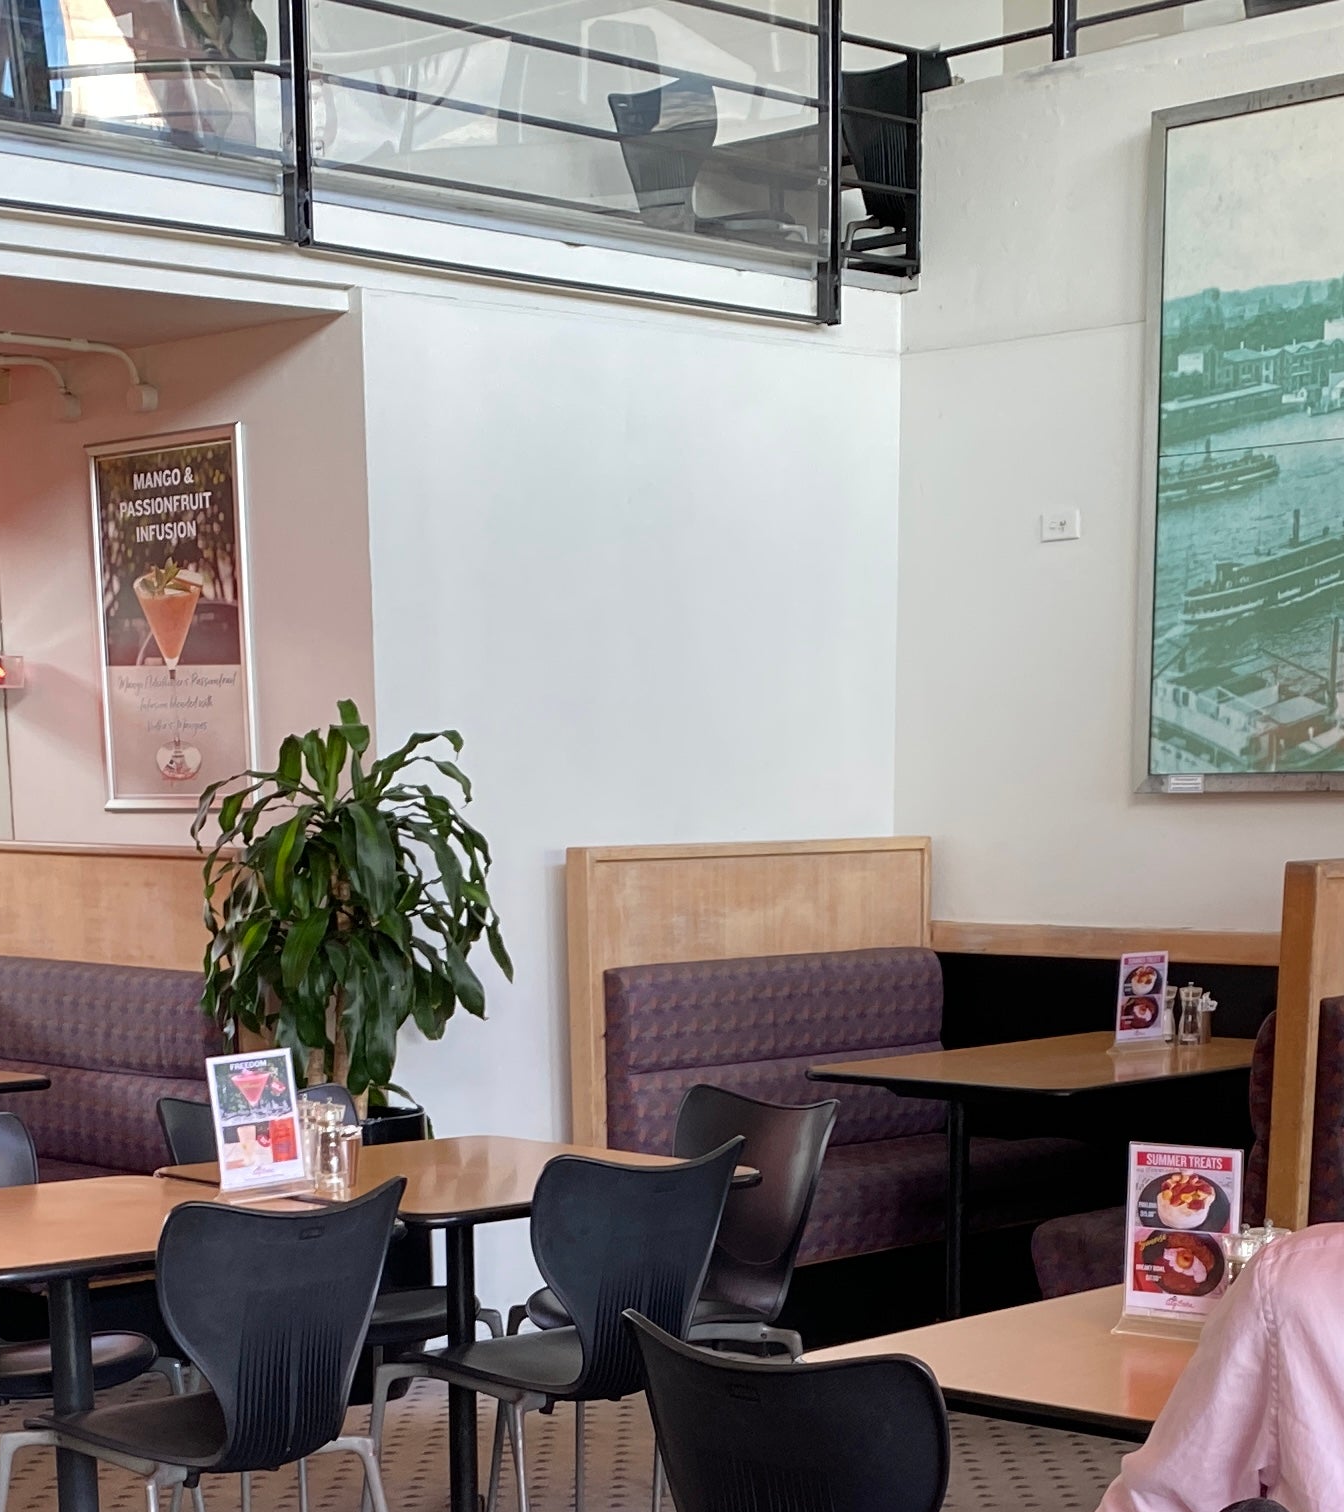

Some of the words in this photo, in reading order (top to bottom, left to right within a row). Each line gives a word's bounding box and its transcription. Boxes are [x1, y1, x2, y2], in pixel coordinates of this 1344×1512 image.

[133, 467, 181, 491] MANGO
[183, 466, 194, 484] &
[119, 491, 212, 519] PASSIONFRUIT
[136, 520, 197, 543] INFUSION
[1146, 1153, 1187, 1167] SUMMER
[1188, 1155, 1224, 1170] TREATS
